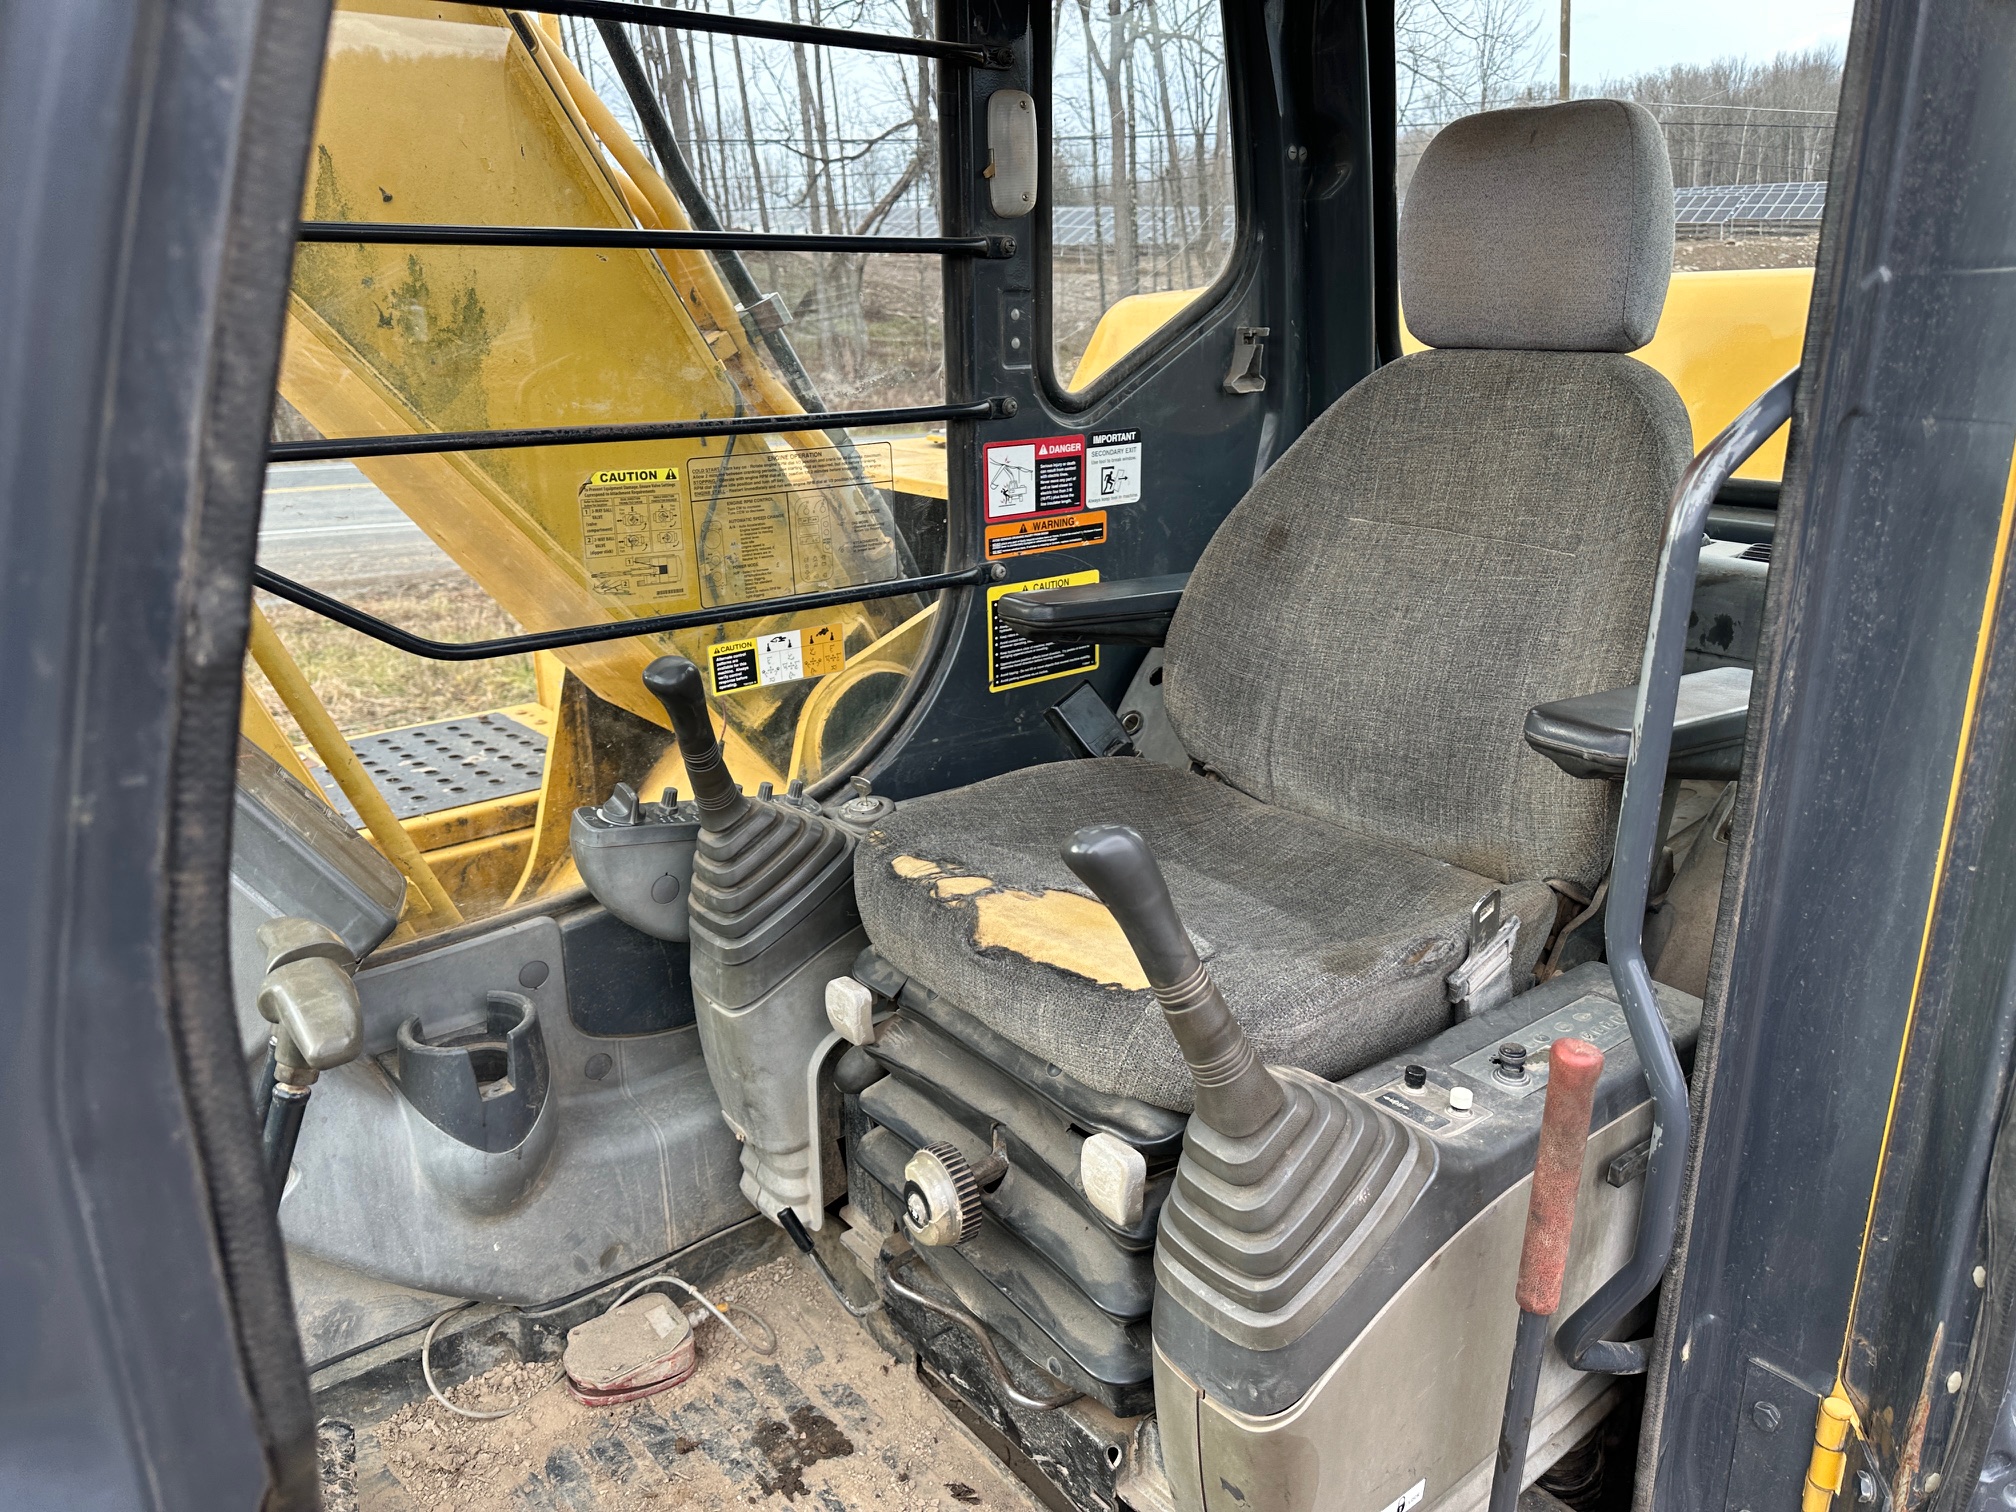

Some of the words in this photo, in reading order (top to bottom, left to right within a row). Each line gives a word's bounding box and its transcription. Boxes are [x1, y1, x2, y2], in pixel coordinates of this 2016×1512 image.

[1093, 432, 1136, 444] IMPORTANT
[1049, 443, 1081, 454] DANGER
[1091, 448, 1124, 457] SECONDARY
[790, 452, 823, 460] OPERATION
[600, 470, 657, 483] CAUTION
[1033, 517, 1075, 531] WARNING
[1033, 578, 1070, 591] CAUTION
[721, 642, 752, 652] CAUTION
